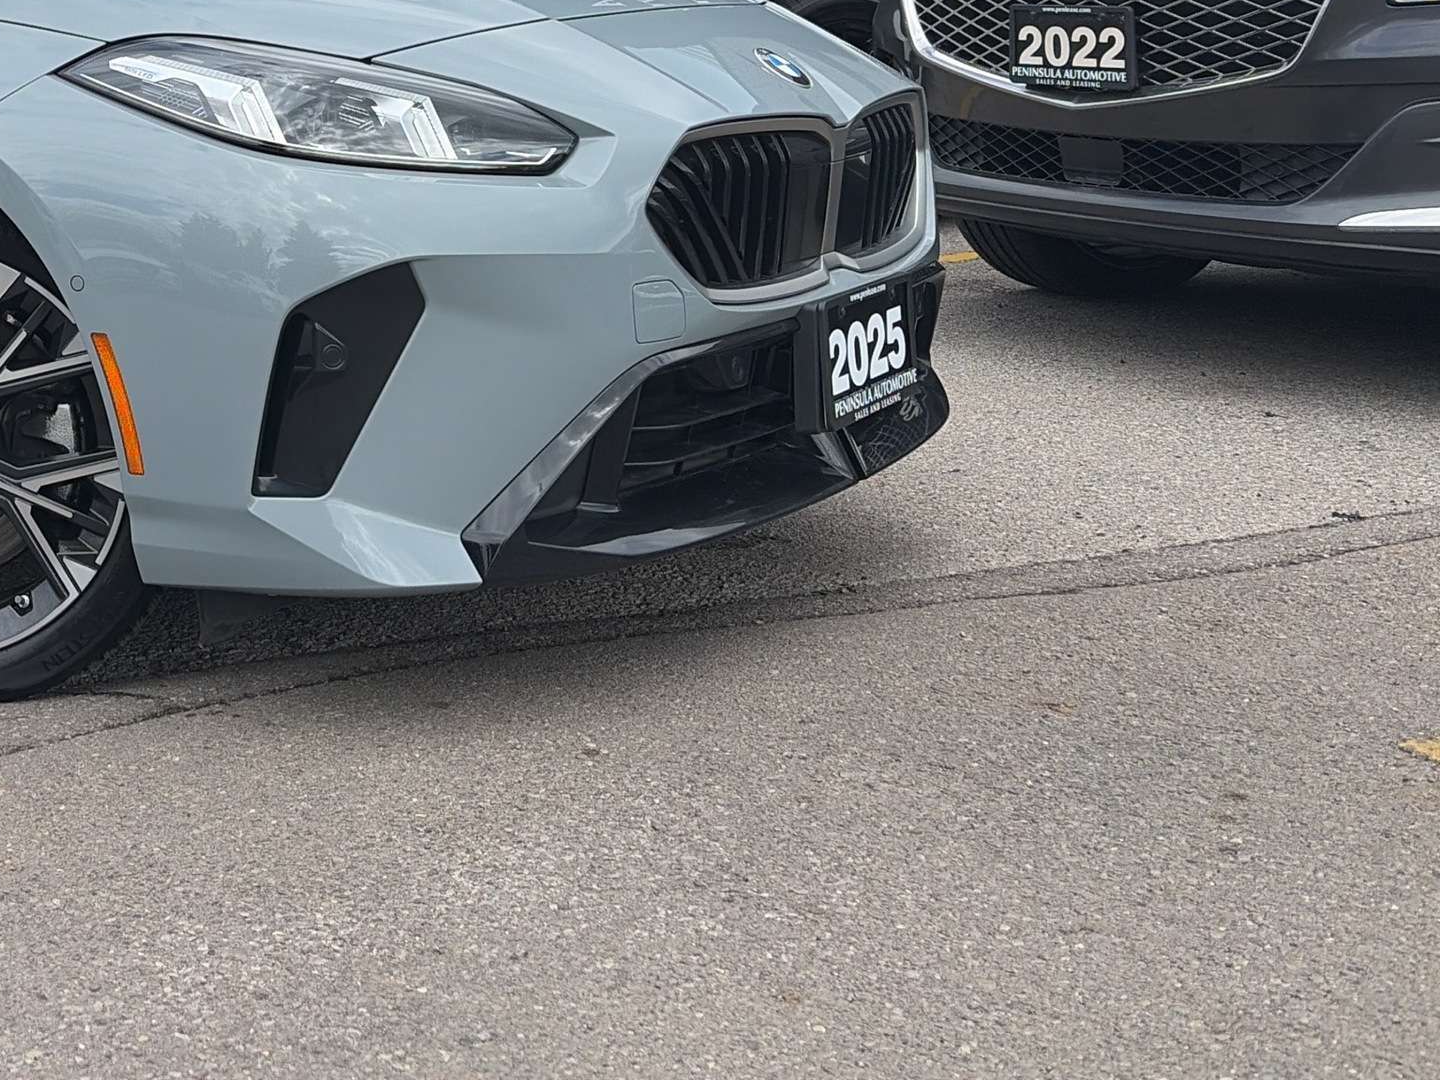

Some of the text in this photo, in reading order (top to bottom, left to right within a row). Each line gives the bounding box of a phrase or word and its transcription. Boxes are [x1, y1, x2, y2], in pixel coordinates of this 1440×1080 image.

[1018, 25, 1126, 69] 2022
[1012, 66, 1127, 83] PENINSULA AUTOMOTIVE
[1056, 79, 1071, 87] AND
[1072, 80, 1101, 88] LEASING
[829, 304, 906, 396] 2025
[834, 368, 918, 419] PENINSULA AUTOMOTIVE
[854, 392, 902, 422] SALES AND LEASING
